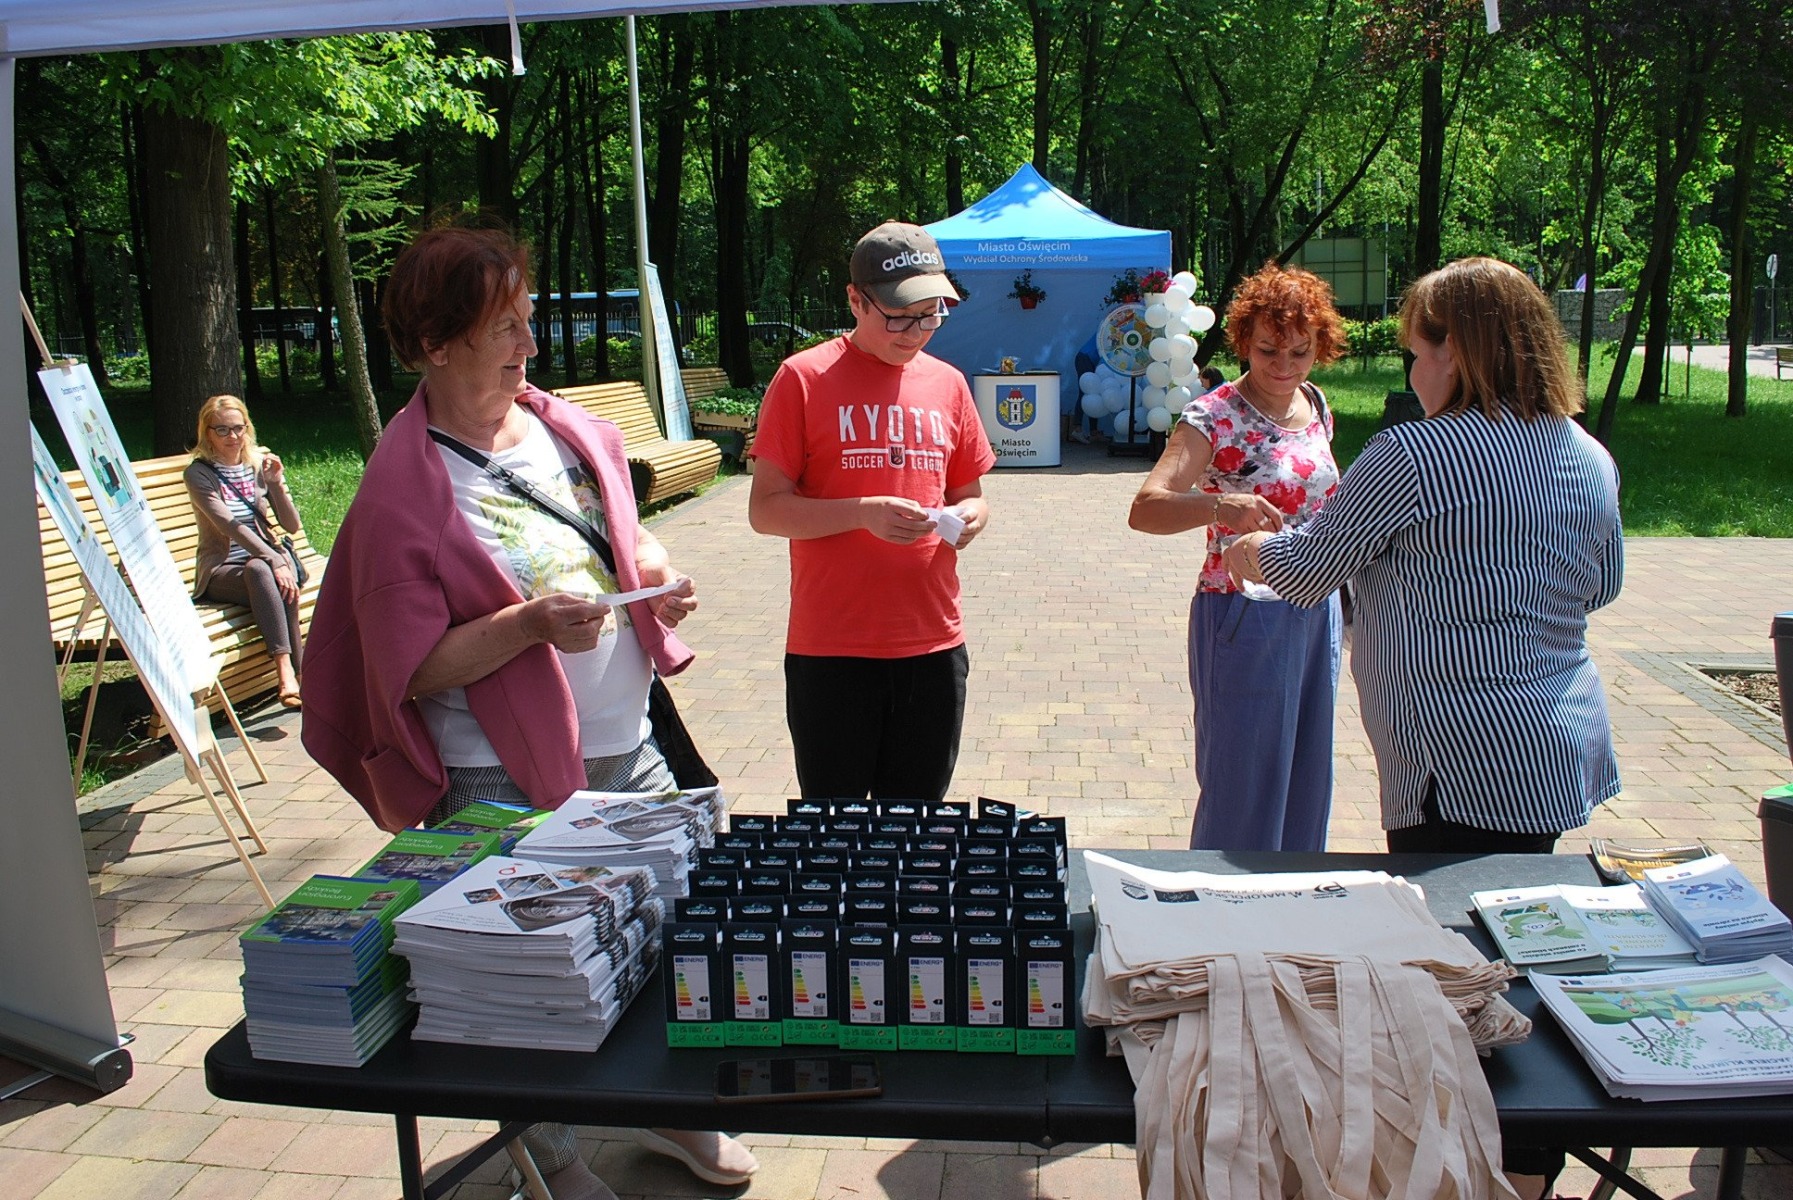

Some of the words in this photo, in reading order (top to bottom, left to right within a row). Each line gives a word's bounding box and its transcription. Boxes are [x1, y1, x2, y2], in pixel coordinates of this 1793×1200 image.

[978, 242, 1015, 252] Miasto
[1017, 241, 1071, 253] Oświęcim
[882, 249, 939, 271] adidas
[963, 255, 998, 265] Wydział
[1000, 254, 1036, 265] Ochrony
[1038, 252, 1089, 263] Środowiska
[838, 404, 946, 446] KYOTO
[1001, 439, 1031, 447] Miasto
[996, 448, 1037, 458] Oświęcim
[842, 455, 884, 469] SOCCER
